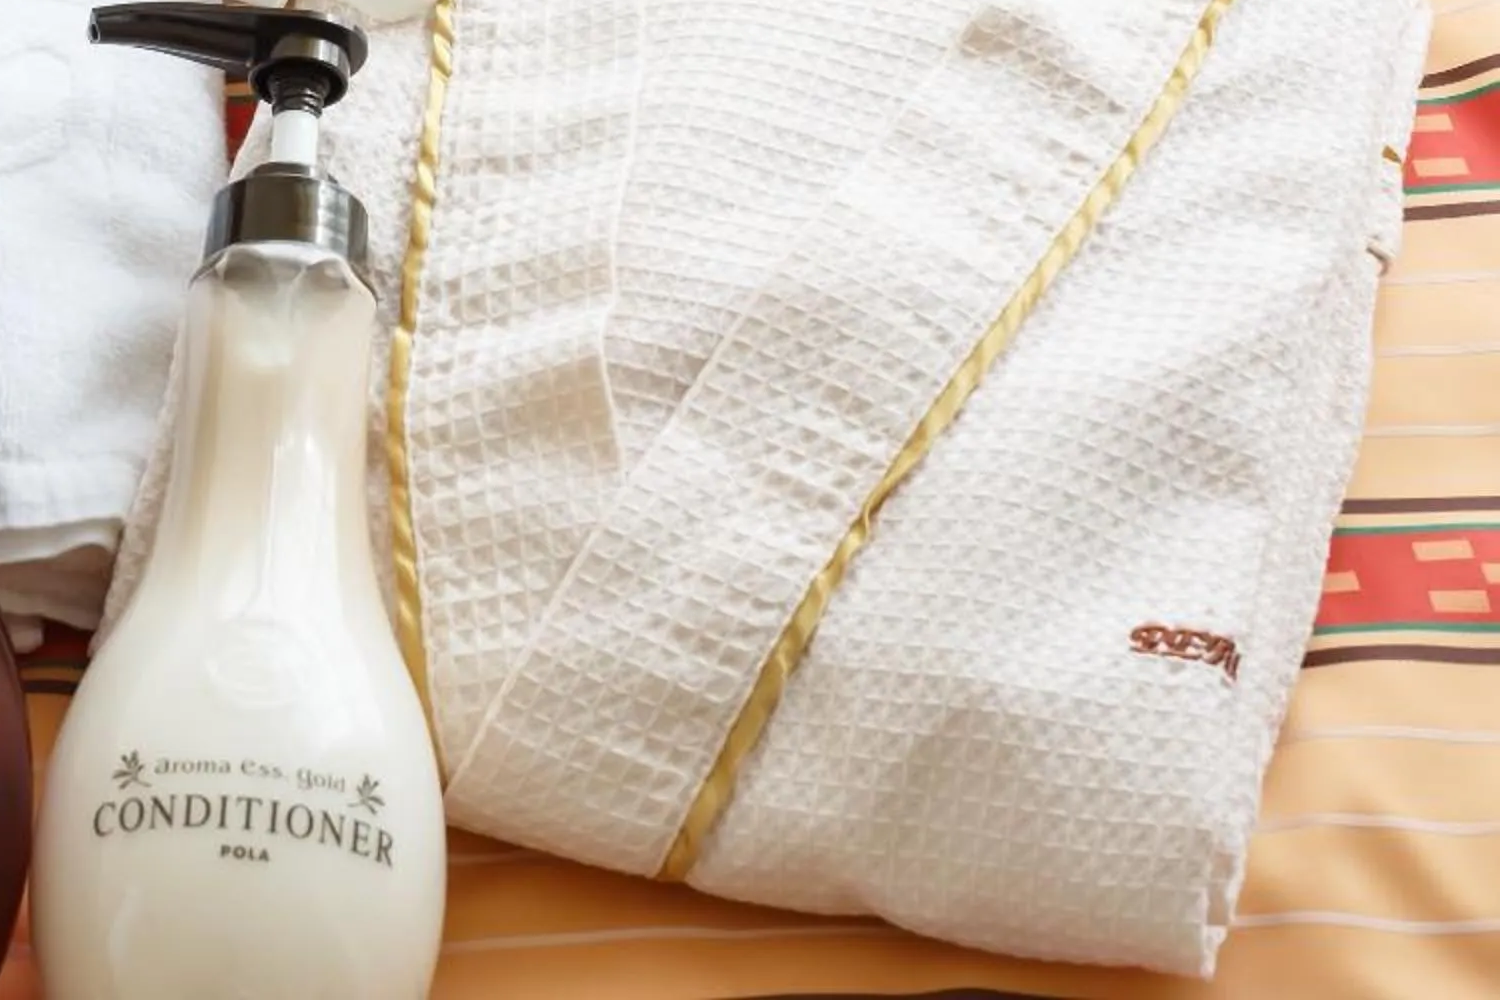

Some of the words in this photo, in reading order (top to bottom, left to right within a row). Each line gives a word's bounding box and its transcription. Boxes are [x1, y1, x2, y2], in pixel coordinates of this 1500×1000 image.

[153, 756, 232, 775] aroma
[296, 767, 346, 793] gold
[92, 793, 395, 870] CONDITIONER
[219, 845, 270, 863] POLA
